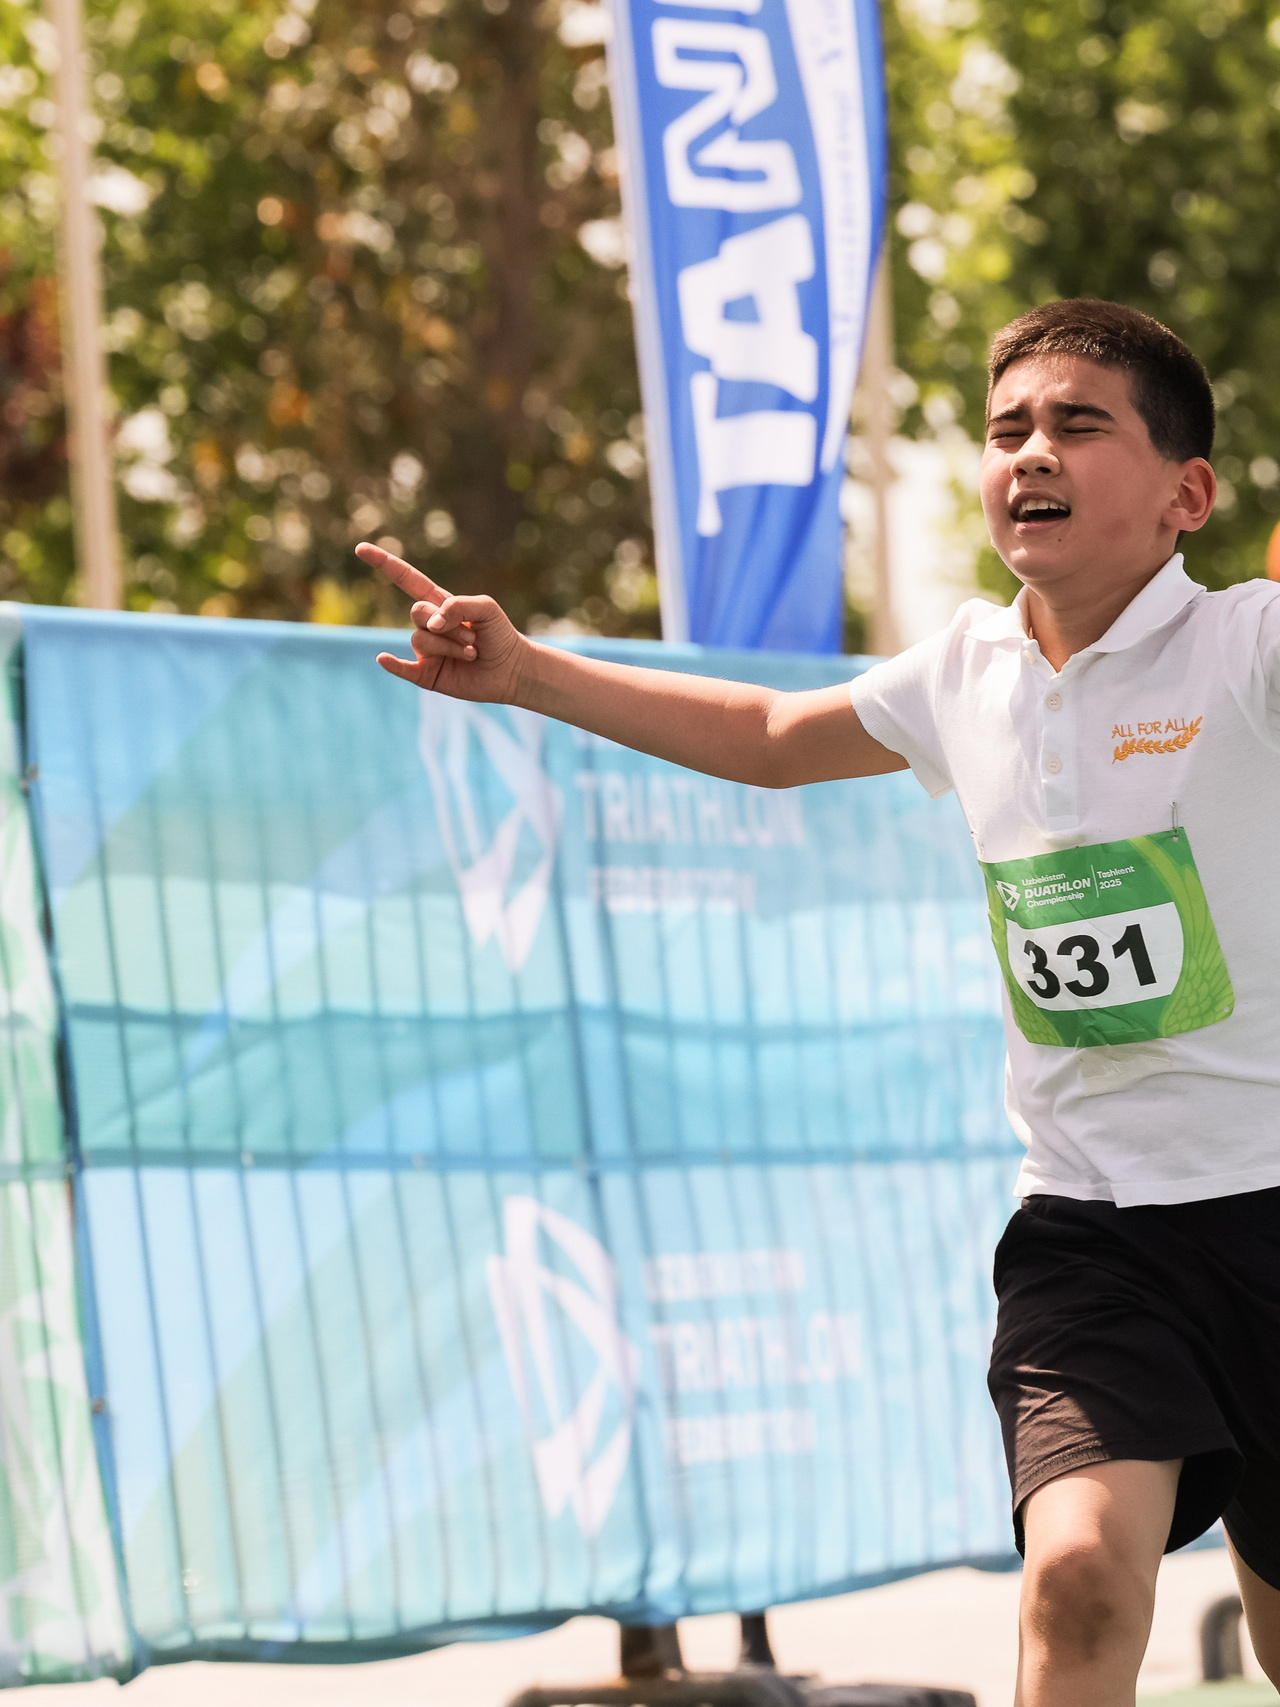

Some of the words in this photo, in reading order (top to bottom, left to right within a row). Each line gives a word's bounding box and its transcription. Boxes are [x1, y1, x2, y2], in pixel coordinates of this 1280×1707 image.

[651, 0, 818, 537] TAN
[1111, 724, 1135, 739] ALL
[1138, 721, 1162, 735] FOR
[1164, 717, 1189, 734] ALL
[1021, 873, 1066, 886] Uzbekistan
[1097, 865, 1135, 879] Tashkent
[1024, 878, 1091, 899] DUATHLON
[1099, 878, 1122, 890] 2025
[1026, 891, 1085, 908] Championship
[1023, 923, 1157, 999] 331
